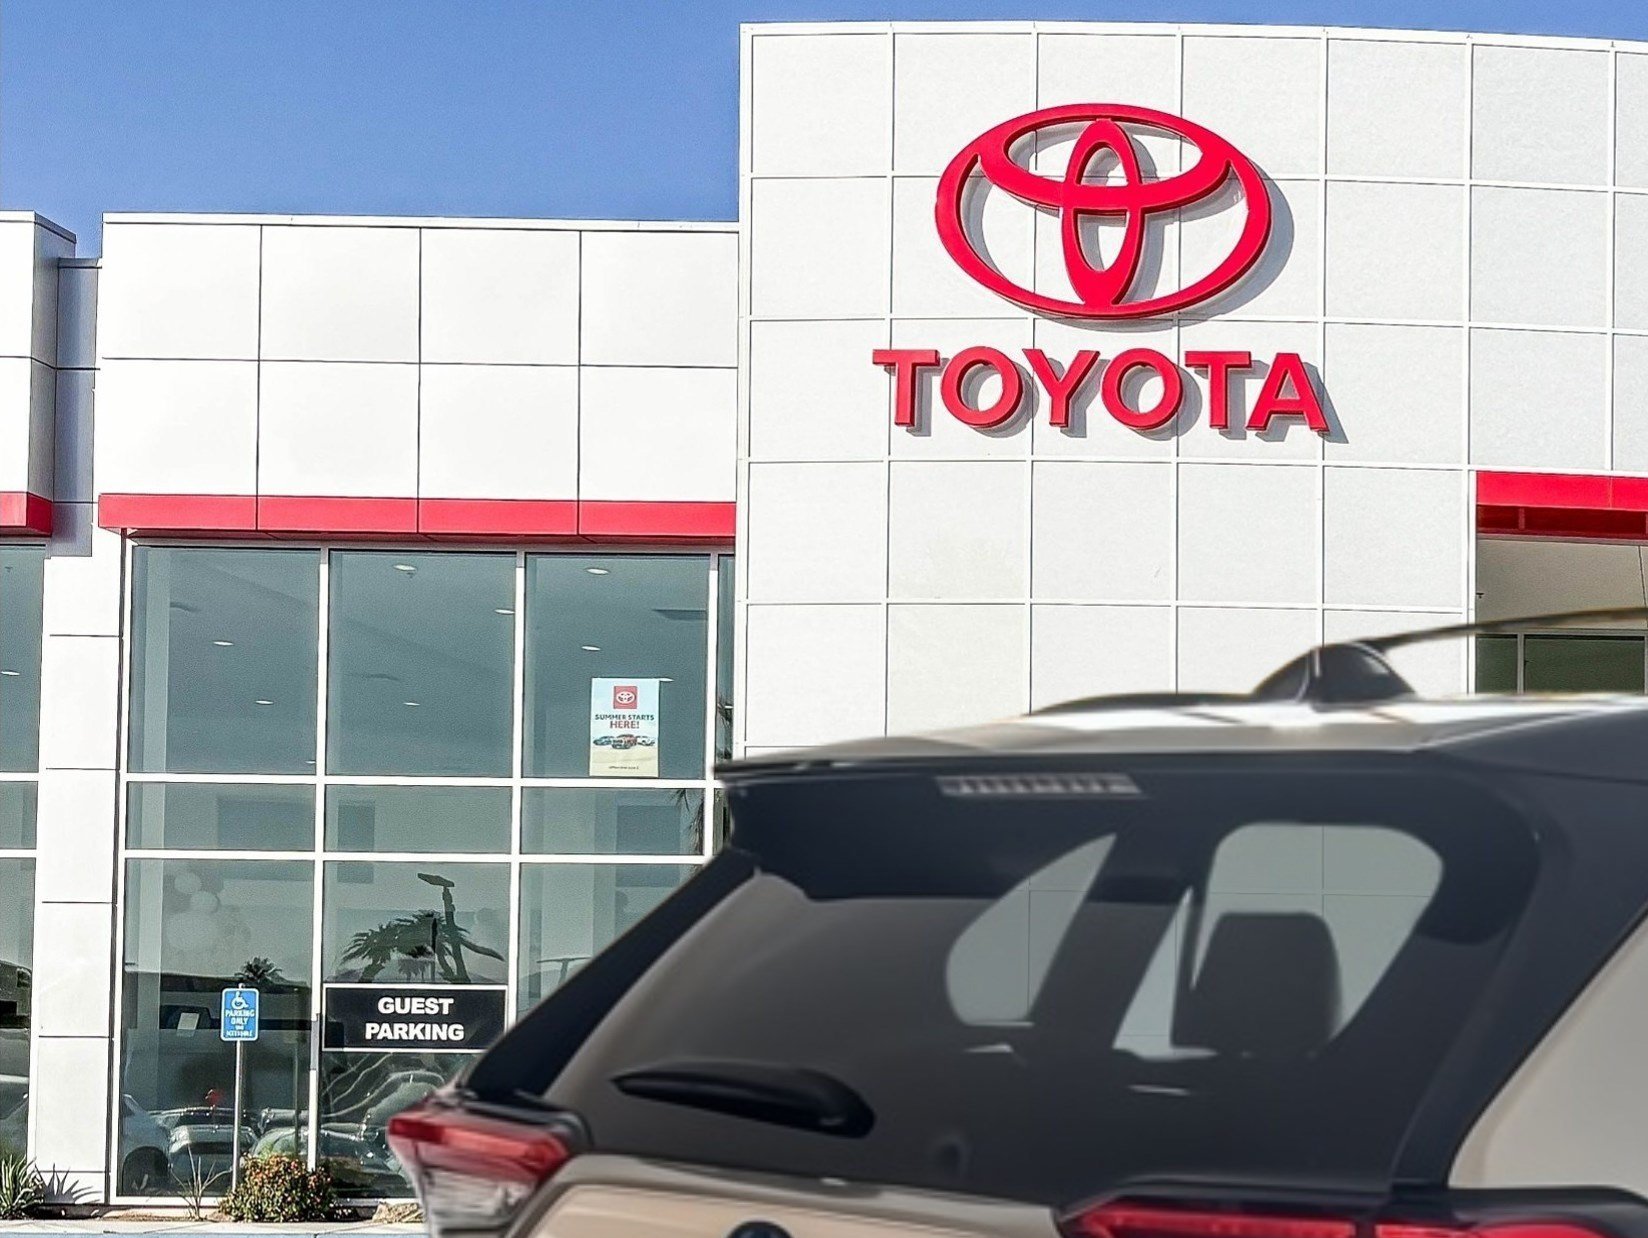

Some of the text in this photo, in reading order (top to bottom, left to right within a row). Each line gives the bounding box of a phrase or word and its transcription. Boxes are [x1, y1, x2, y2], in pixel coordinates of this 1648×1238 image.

[872, 346, 1329, 433] TOYOTA
[594, 713, 655, 721] SUMMER STARTS
[609, 720, 640, 729] HERE!
[377, 996, 455, 1015] GUEST
[225, 1009, 256, 1017] PARKING
[364, 1022, 465, 1041] PARKING
